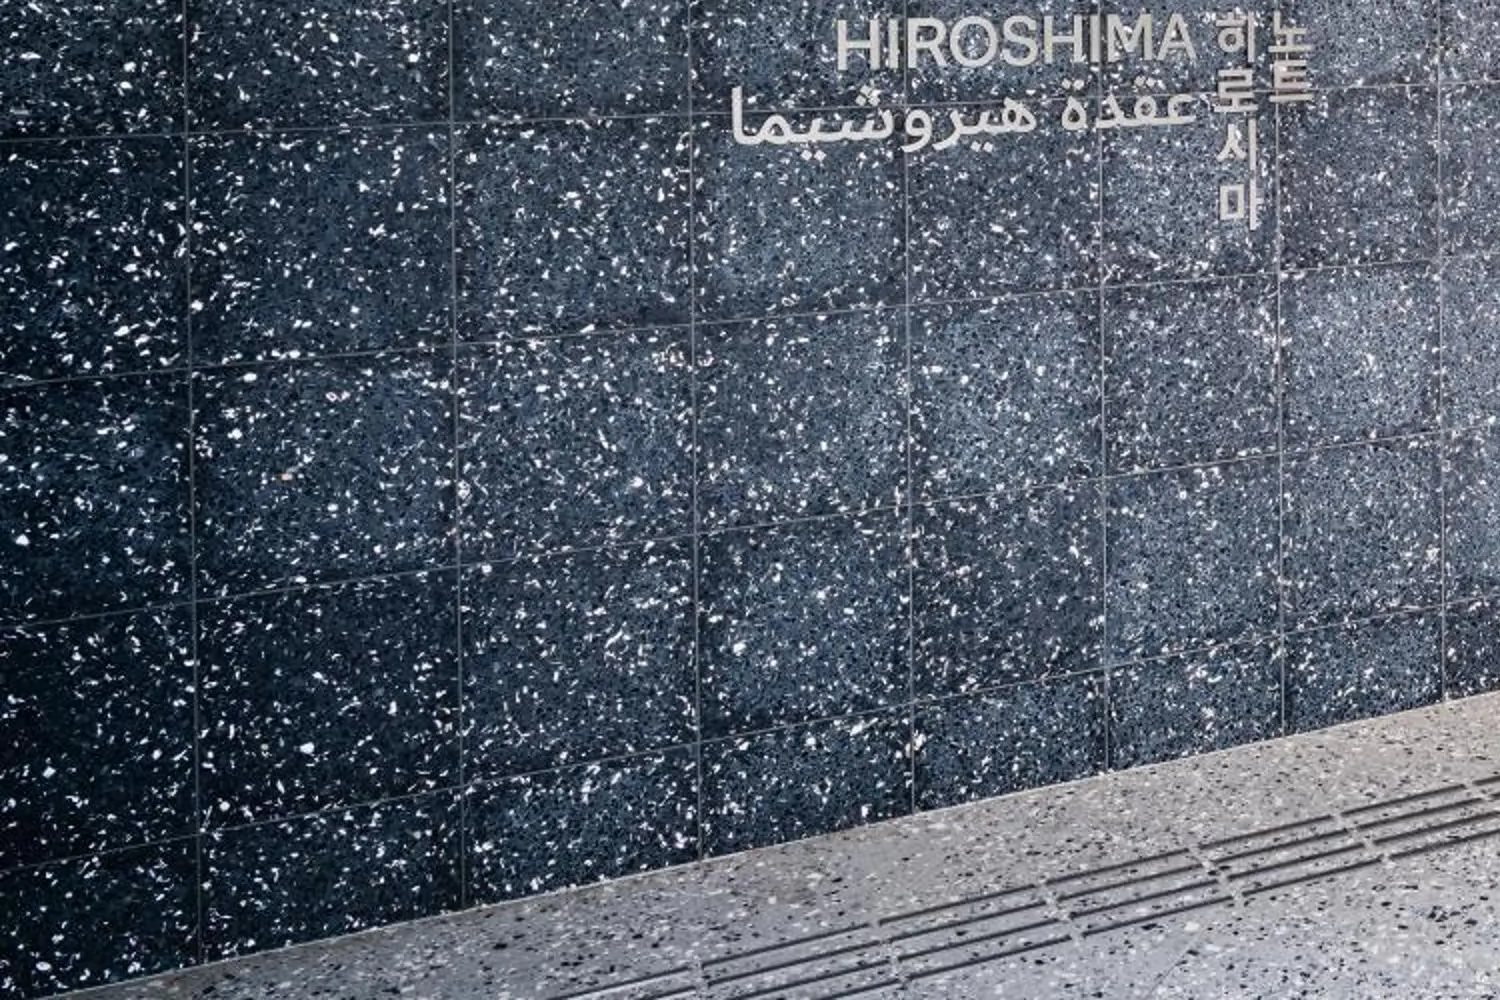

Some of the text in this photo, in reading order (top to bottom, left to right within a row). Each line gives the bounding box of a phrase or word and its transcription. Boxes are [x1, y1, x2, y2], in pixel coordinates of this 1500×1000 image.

[836, 13, 1197, 71] HIROSHIMA
[731, 76, 1196, 161] عقدة هيروشيما
[1213, 10, 1261, 232] 히로시마
